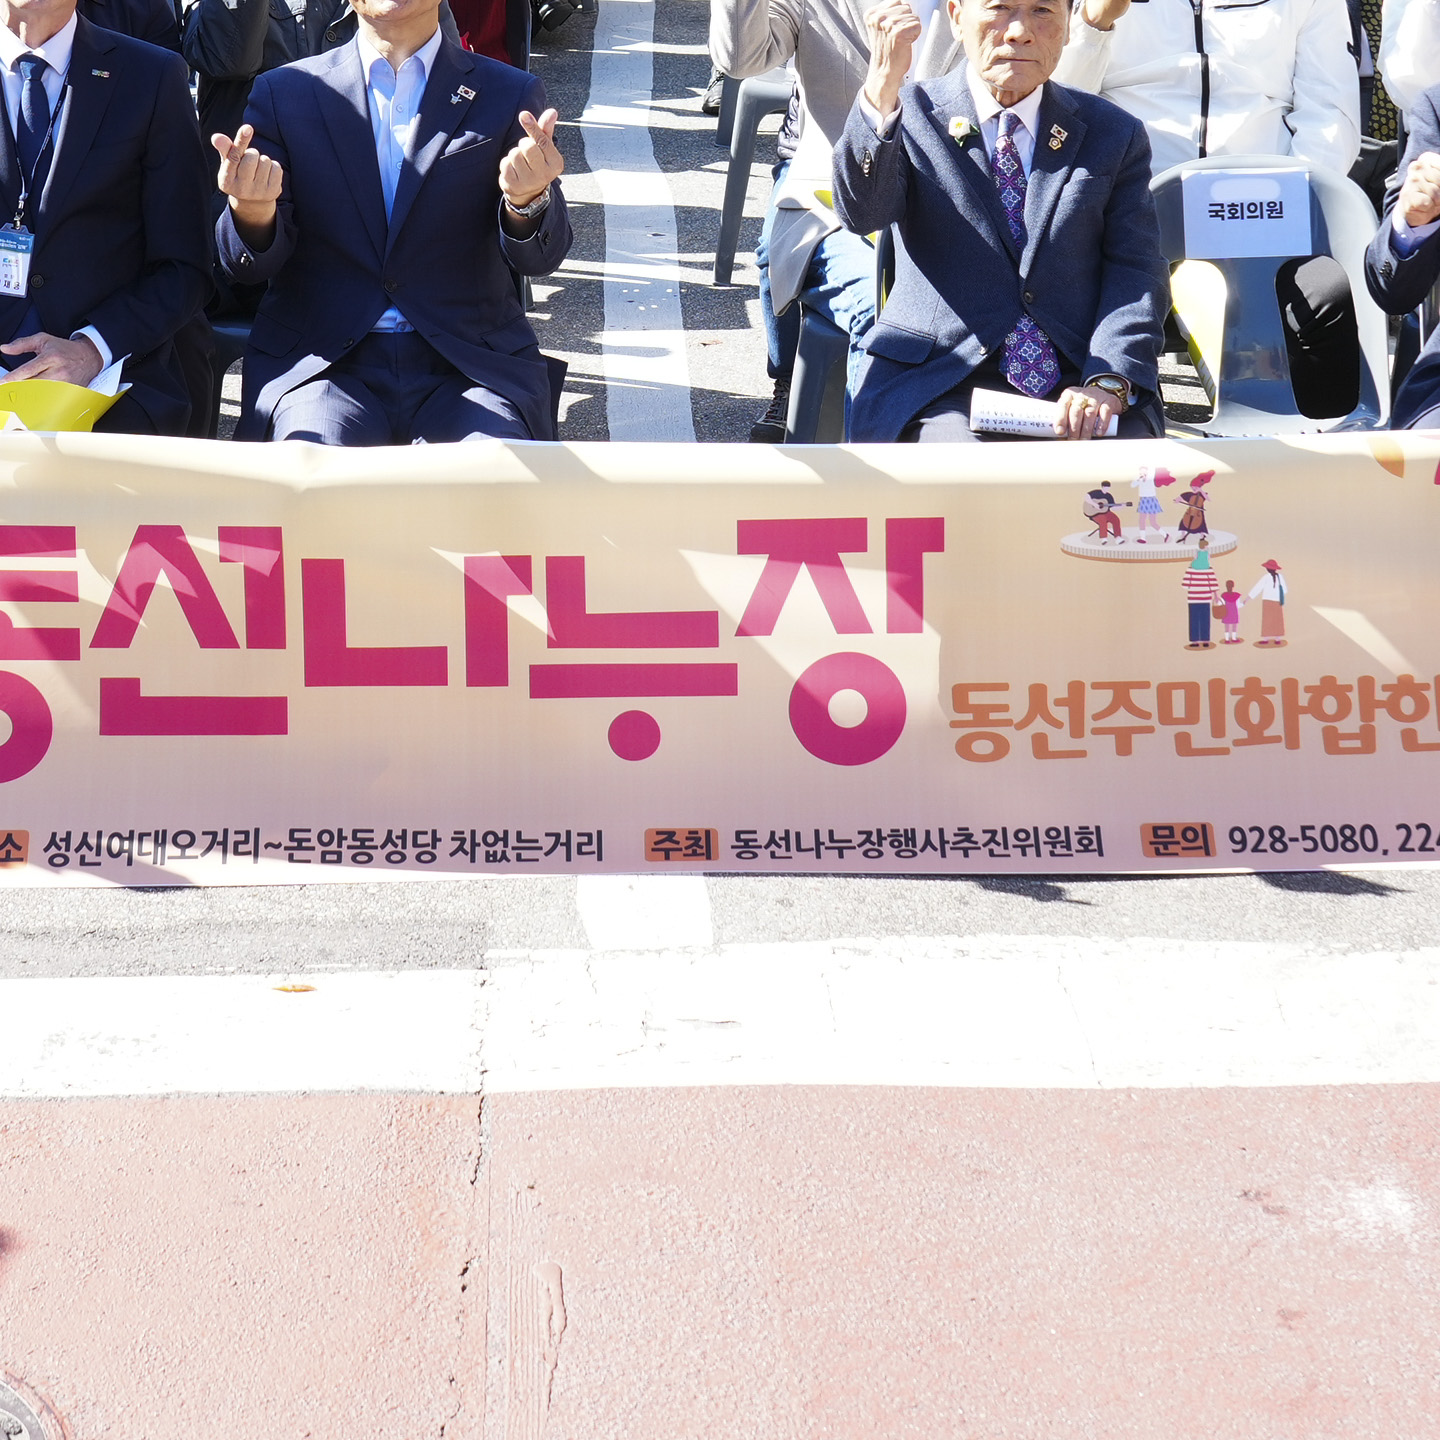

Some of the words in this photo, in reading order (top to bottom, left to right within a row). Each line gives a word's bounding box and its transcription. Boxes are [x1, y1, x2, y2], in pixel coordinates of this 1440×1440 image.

[1207, 199, 1284, 222] 국회의원
[448, 826, 605, 864] 차없는거리
[651, 830, 713, 860] 주최
[730, 825, 1104, 861] 동선나누장행사추진위원회
[1148, 824, 1214, 856] 문의
[1228, 824, 1389, 857] 928-5080,
